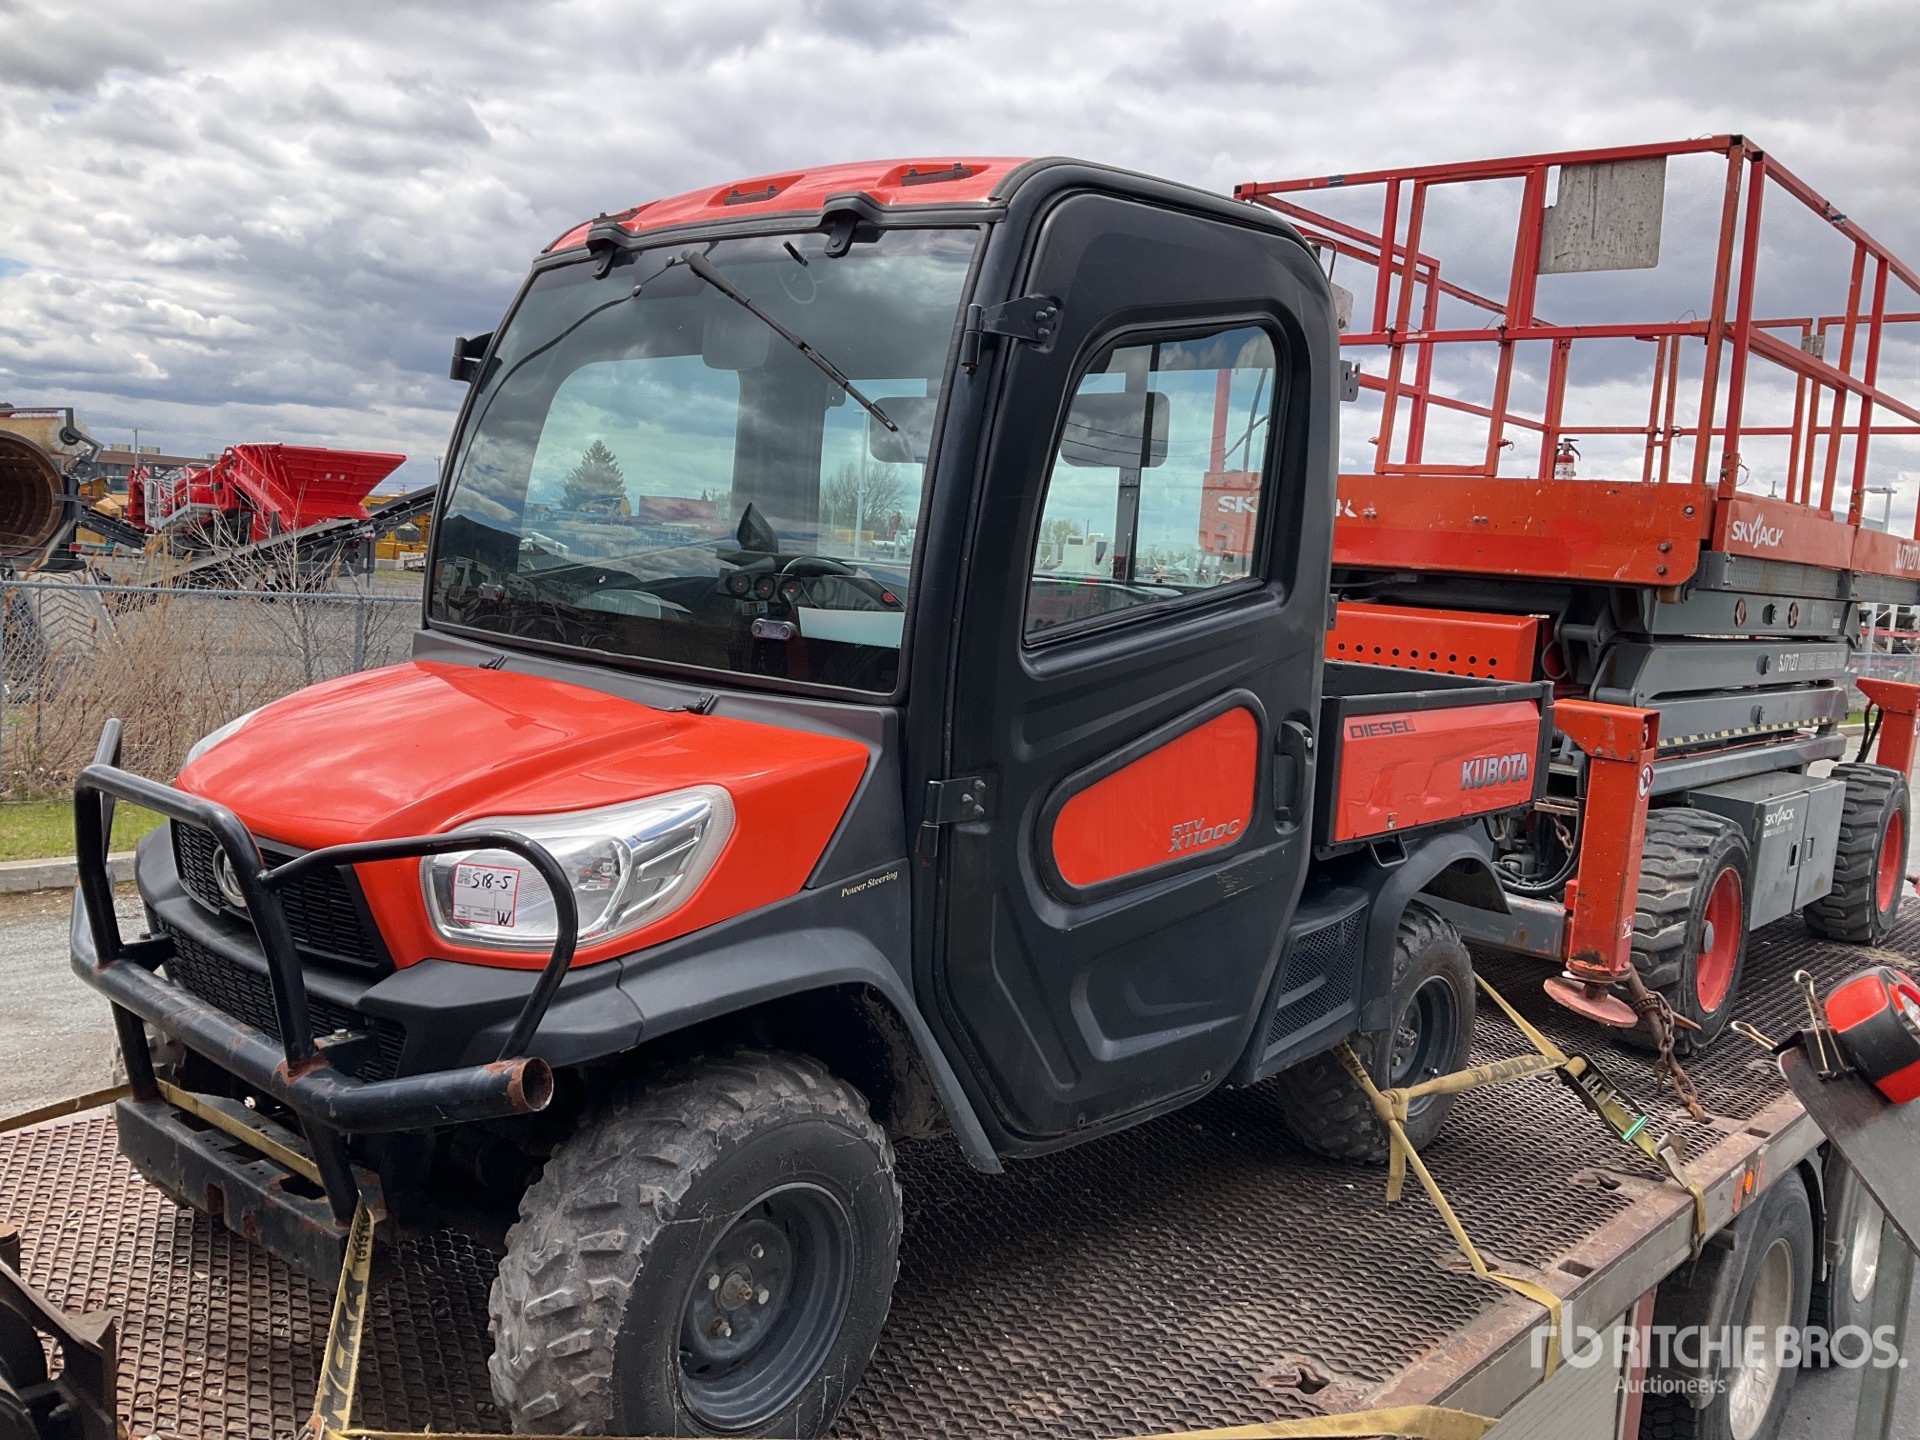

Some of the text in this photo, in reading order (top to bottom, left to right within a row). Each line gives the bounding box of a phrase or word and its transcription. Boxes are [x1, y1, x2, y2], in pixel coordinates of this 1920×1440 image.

[1731, 512, 1784, 549] SKYJACK
[1349, 720, 1416, 739] DIESEL
[1460, 752, 1528, 790] KUBOTA
[1171, 817, 1205, 837] RTV
[1764, 804, 1795, 826] SKYJACK
[1168, 819, 1240, 853] X1100C
[471, 871, 513, 890] S18-5
[841, 870, 898, 898] Power Steering
[496, 910, 512, 926] W
[319, 1267, 364, 1430] NCRA
